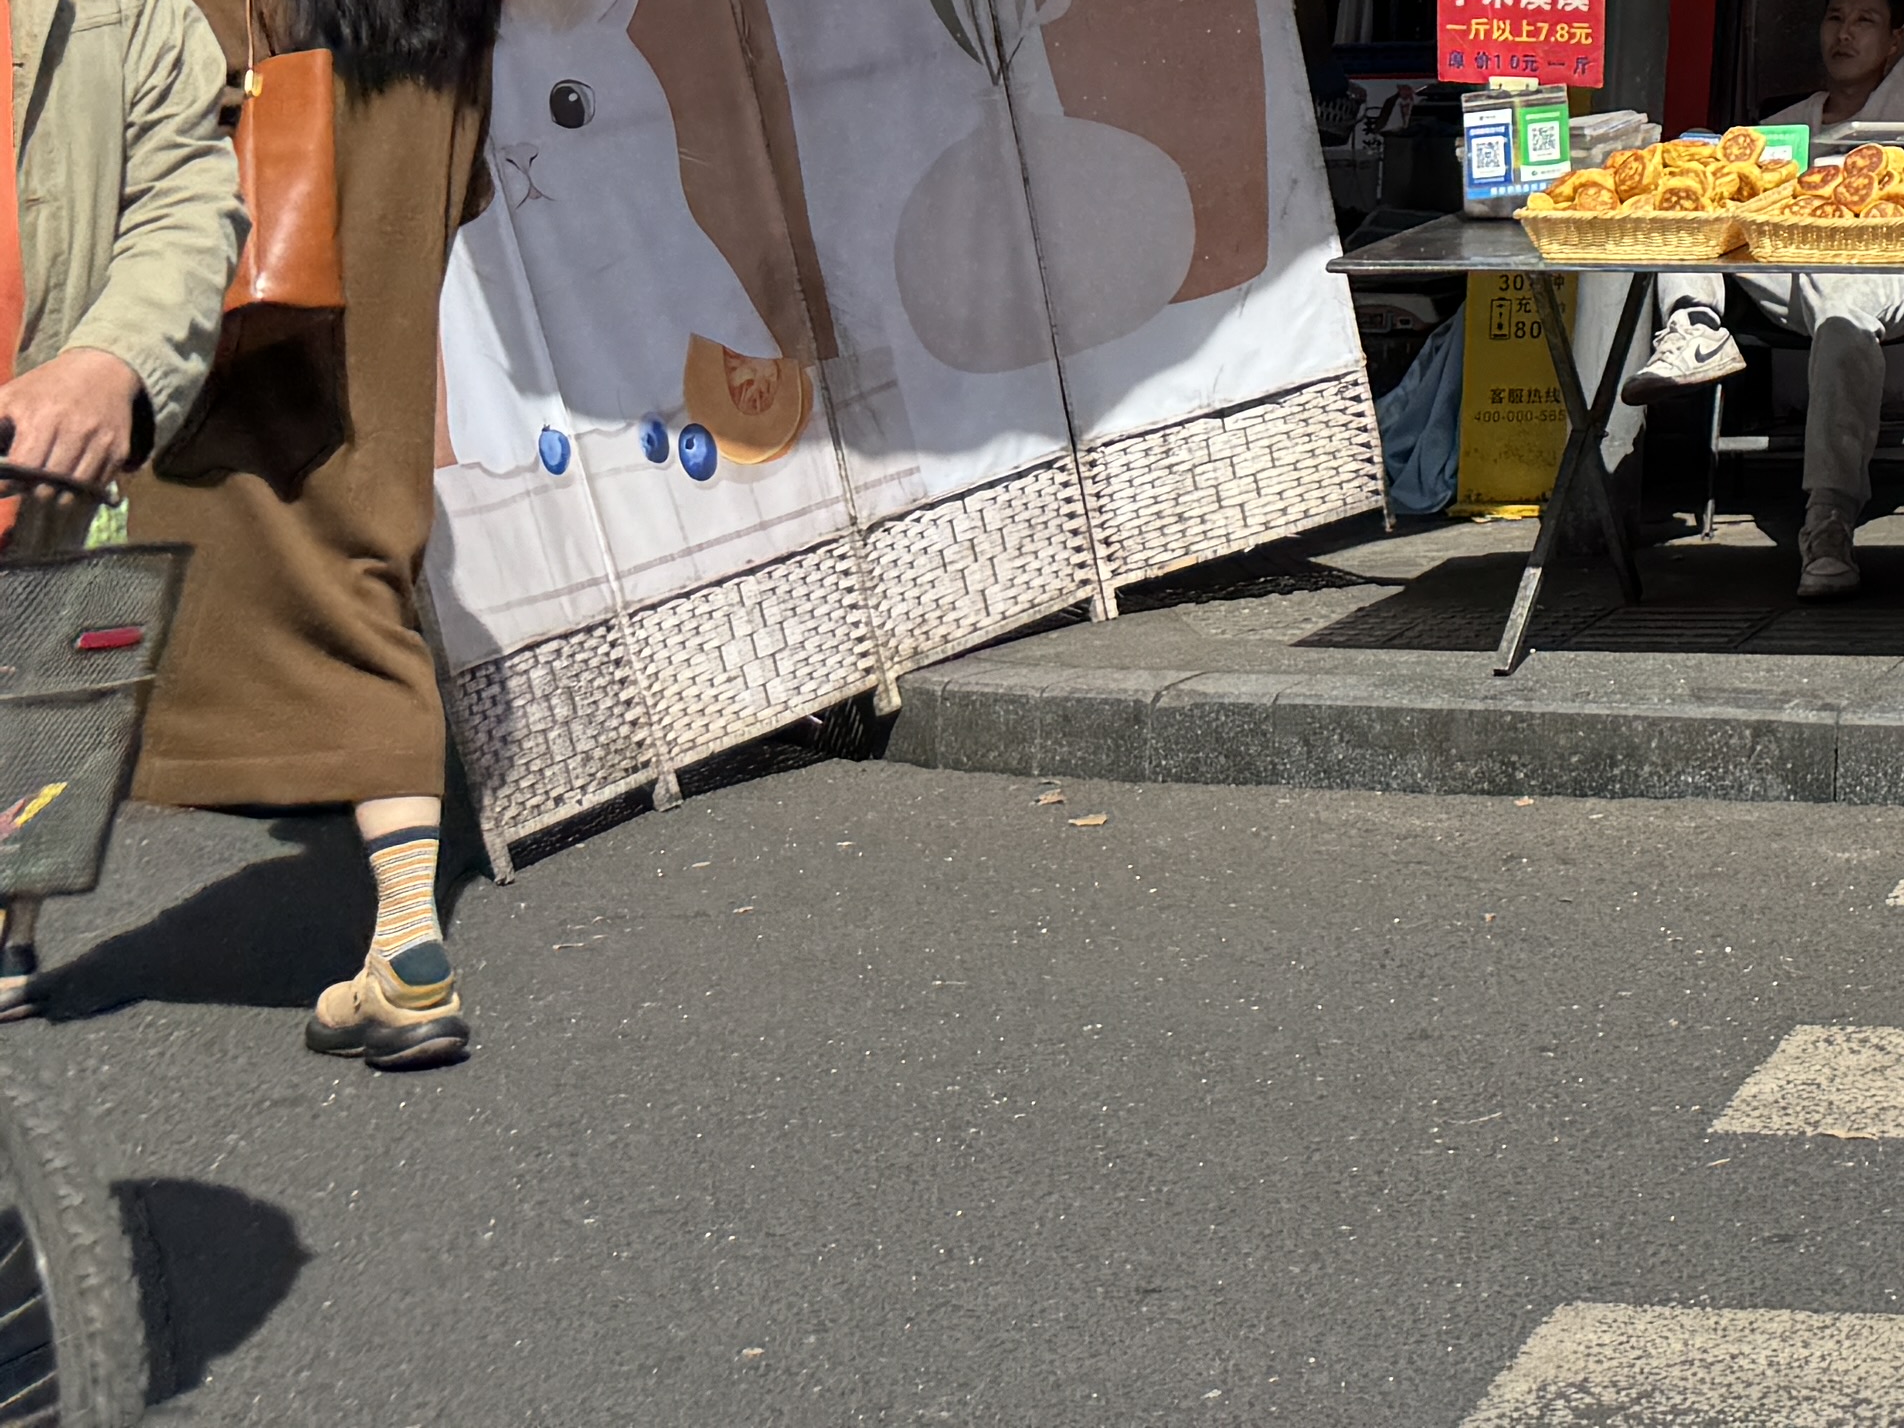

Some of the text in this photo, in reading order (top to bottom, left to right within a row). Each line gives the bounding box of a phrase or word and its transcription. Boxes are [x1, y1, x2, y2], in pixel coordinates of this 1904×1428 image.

[1445, 18, 1593, 45] 一斤以上7.8元
[1489, 387, 1561, 404] 客服热线
